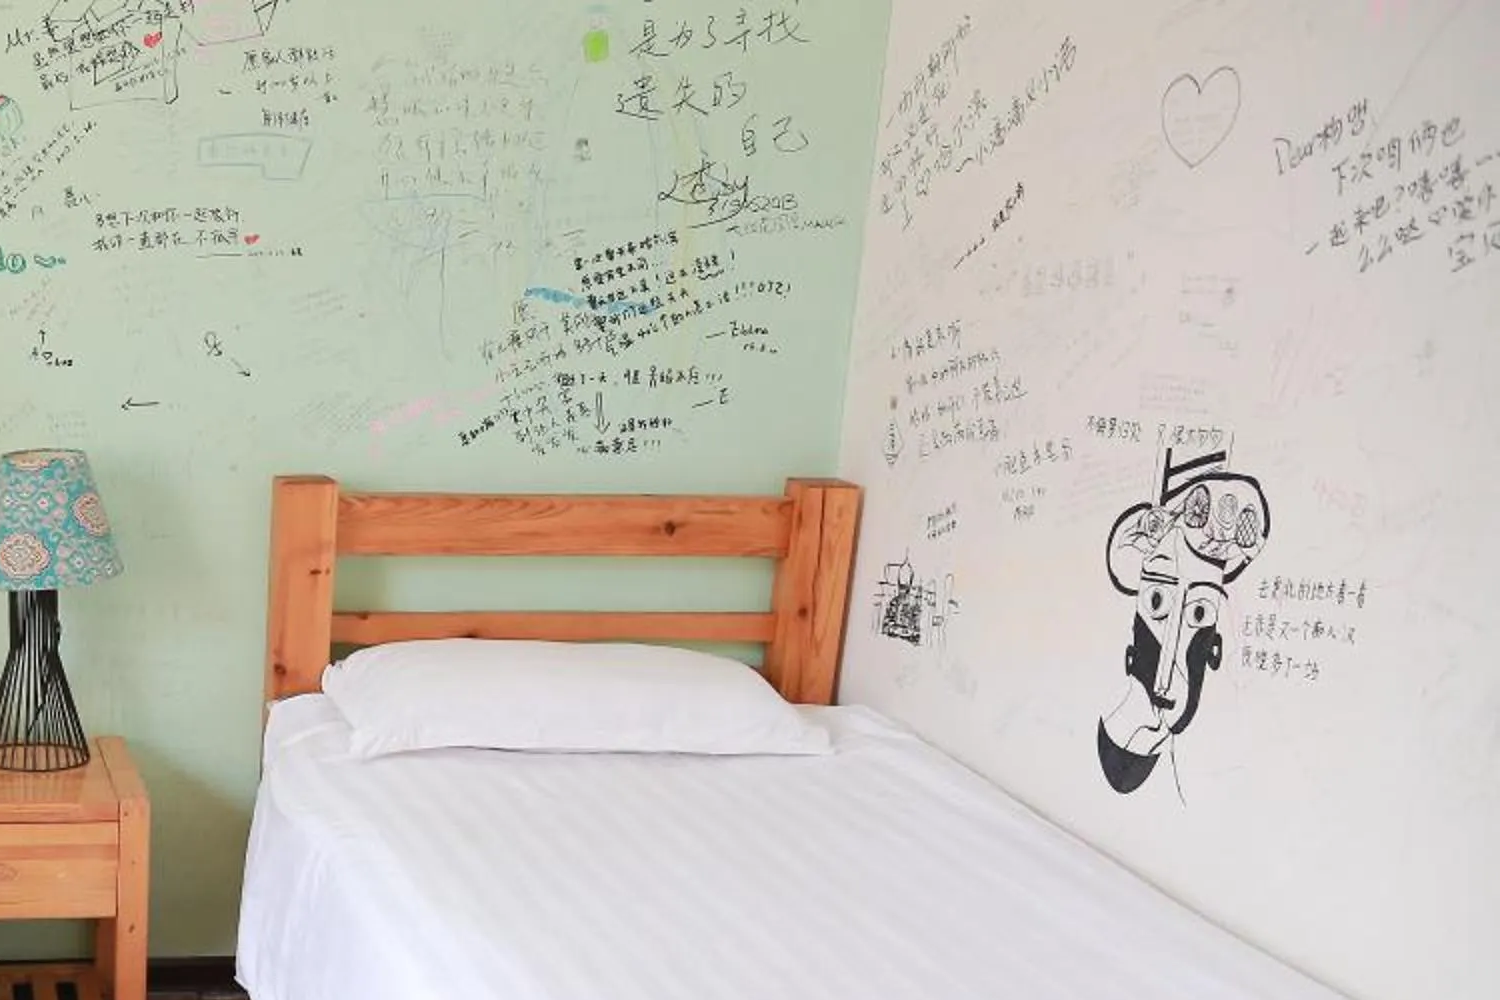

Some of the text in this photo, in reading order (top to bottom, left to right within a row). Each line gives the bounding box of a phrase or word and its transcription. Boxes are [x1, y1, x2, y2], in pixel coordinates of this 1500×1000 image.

[628, 8, 812, 59] 是为了寻找
[741, 113, 810, 158] 自己
